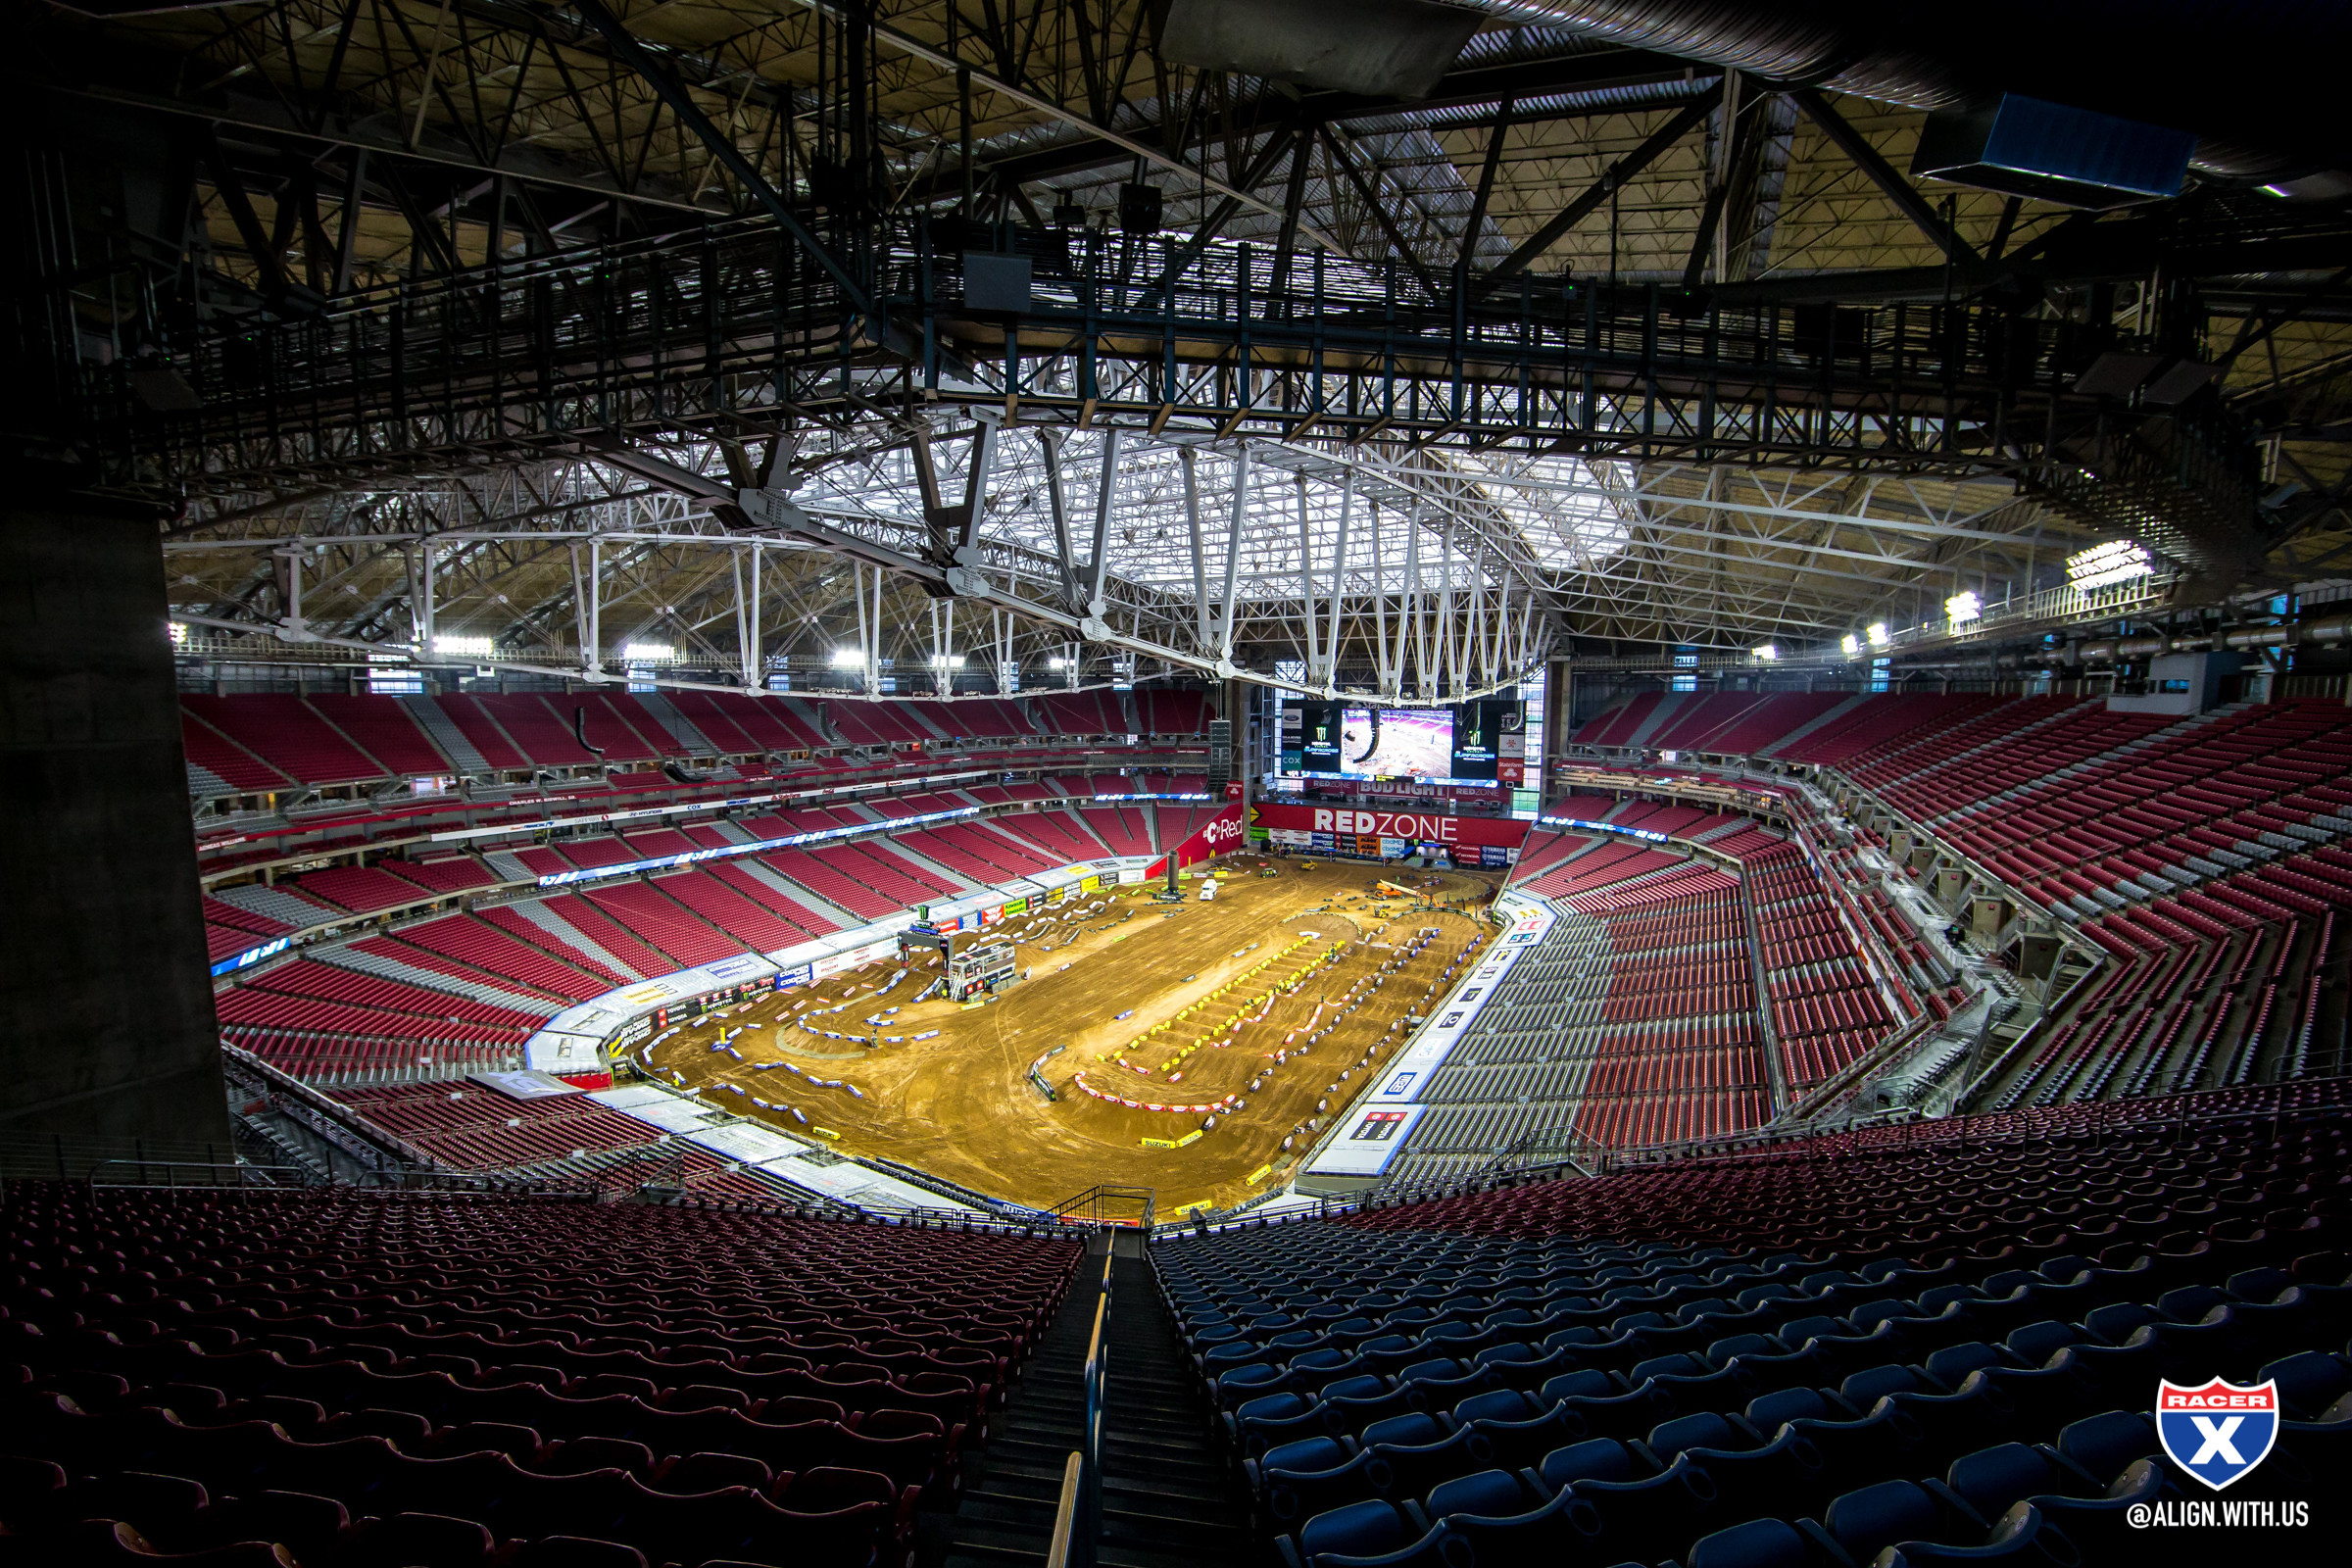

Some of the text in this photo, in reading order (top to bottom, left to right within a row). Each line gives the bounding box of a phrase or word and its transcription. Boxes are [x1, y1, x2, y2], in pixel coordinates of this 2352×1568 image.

[1360, 781, 1444, 796] BUD LIGHT
[1456, 788, 1499, 797] REDZONE
[1220, 814, 1243, 841] Red
[1314, 809, 1458, 841] REDZONE
[1005, 900, 1025, 909] Kawasaki
[666, 1004, 686, 1013] TOYOTA
[708, 998, 733, 1009] MONSTER
[667, 1013, 688, 1023] TOYOTA
[1355, 1121, 1377, 1140] TOYOTA
[1376, 1121, 1396, 1140] TOYOTA
[1182, 1133, 1200, 1145] SUZUKI
[1252, 1168, 1269, 1182] SUZUKI
